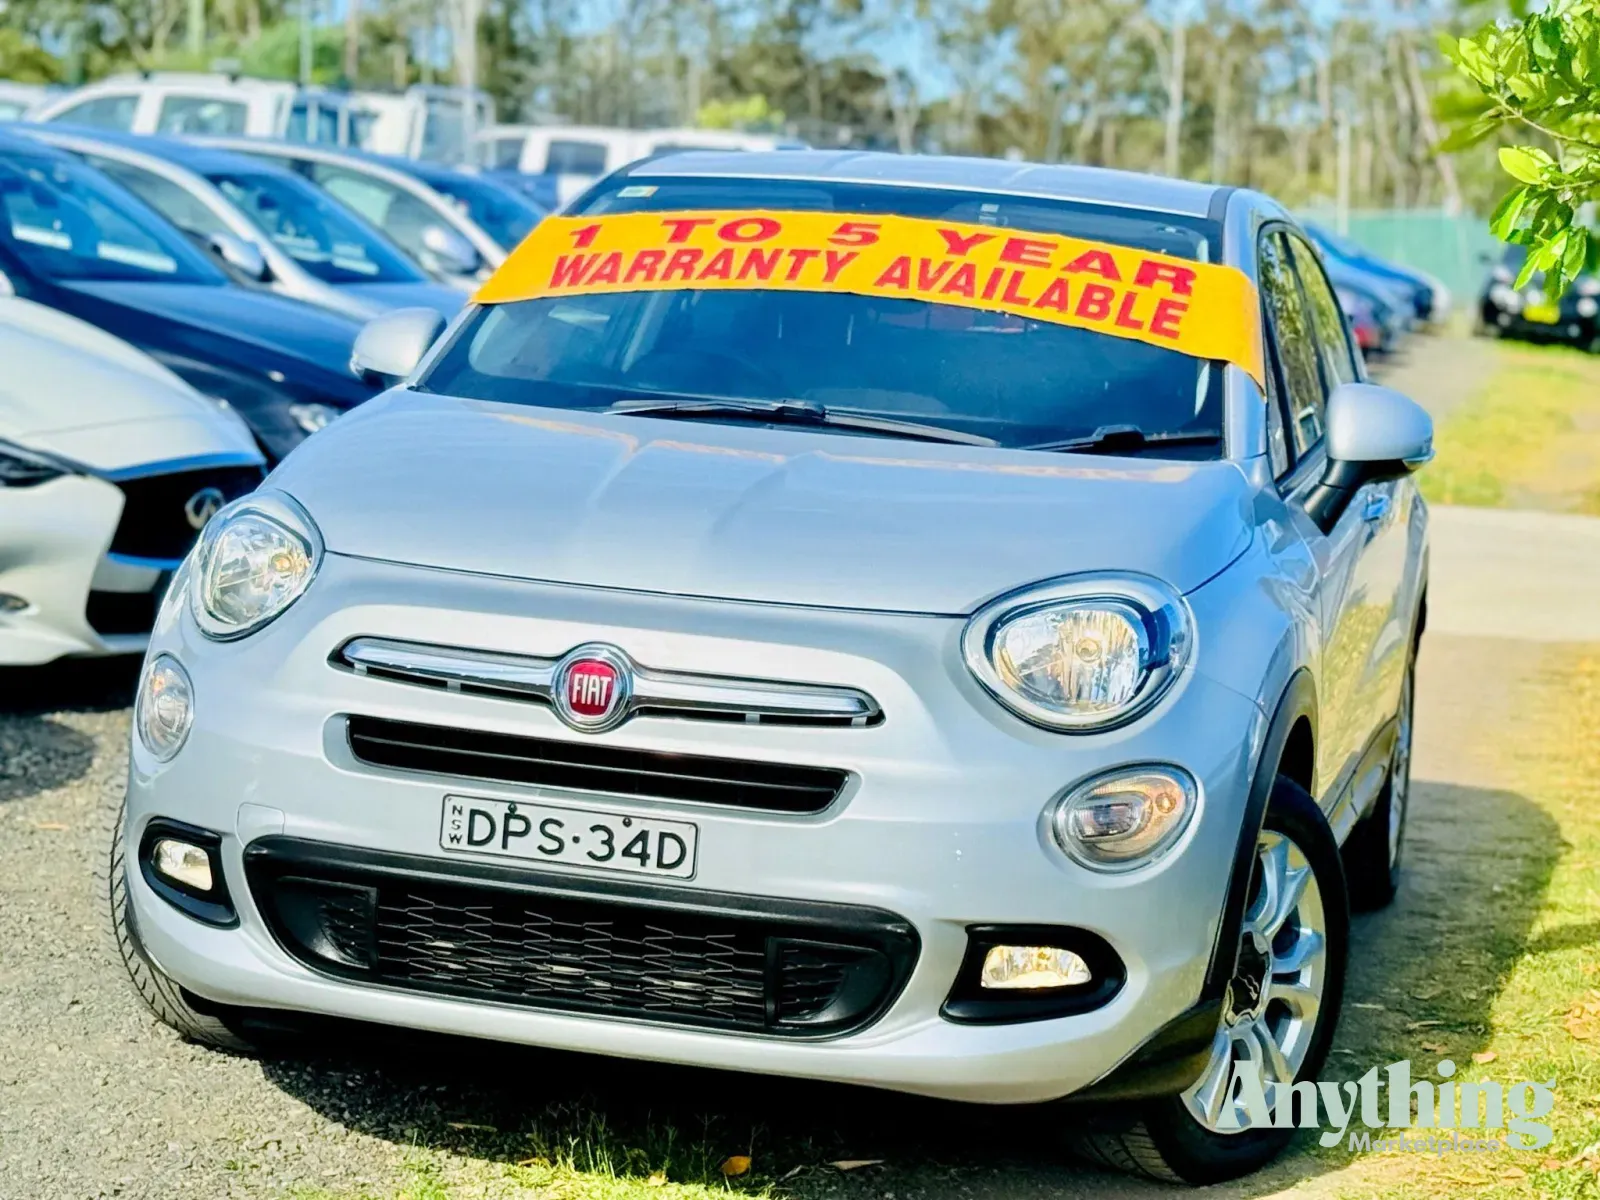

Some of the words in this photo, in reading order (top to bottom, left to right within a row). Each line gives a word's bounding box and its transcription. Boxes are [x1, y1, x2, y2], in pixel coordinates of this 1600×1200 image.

[548, 247, 860, 290] WARRANTY
[874, 255, 1190, 340] AVAILABLE
[568, 224, 603, 249] 1
[661, 217, 783, 244] TO
[826, 221, 883, 247] 5
[936, 227, 1198, 297] YEAR
[571, 673, 612, 707] FIAT
